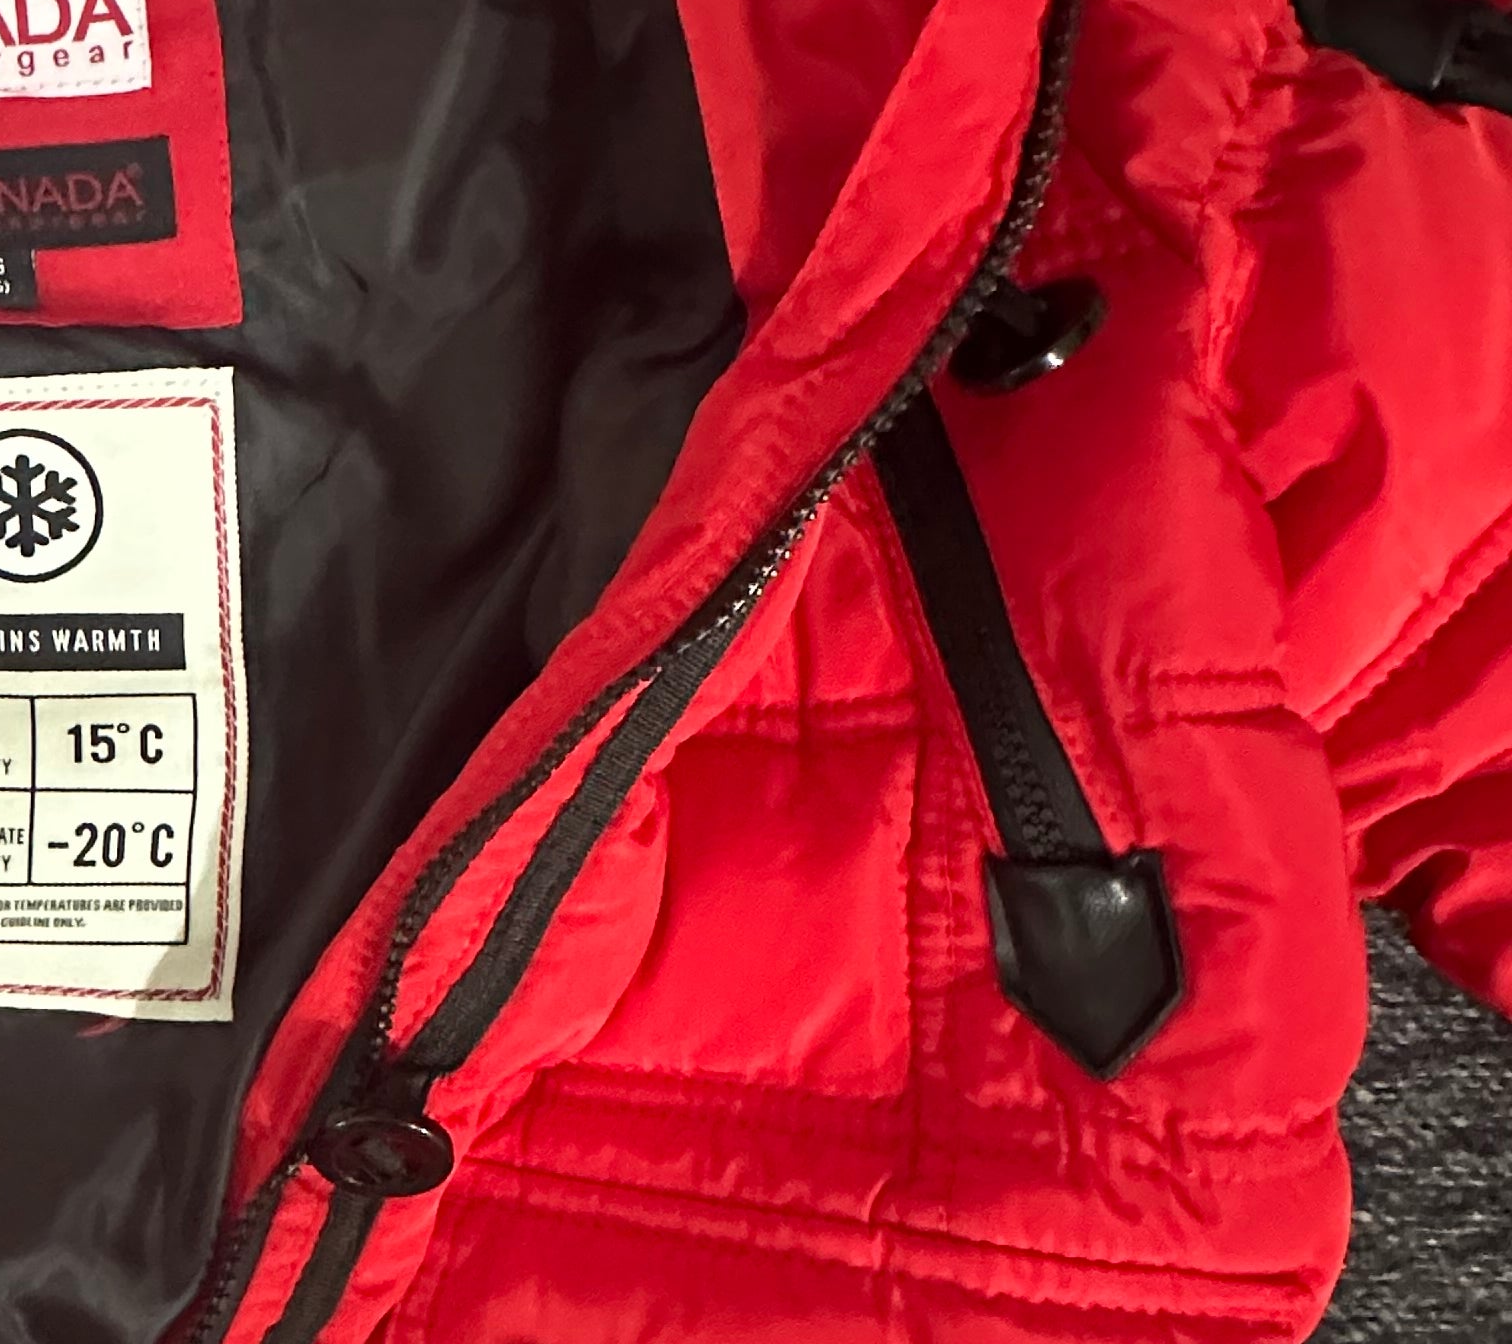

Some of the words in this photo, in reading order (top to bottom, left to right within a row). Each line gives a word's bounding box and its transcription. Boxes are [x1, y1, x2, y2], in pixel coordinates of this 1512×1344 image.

[51, 628, 161, 653] WARMTH
[14, 898, 101, 912] TEMPERATURES
[103, 898, 126, 912] ARE
[129, 898, 183, 912] PROVIDED
